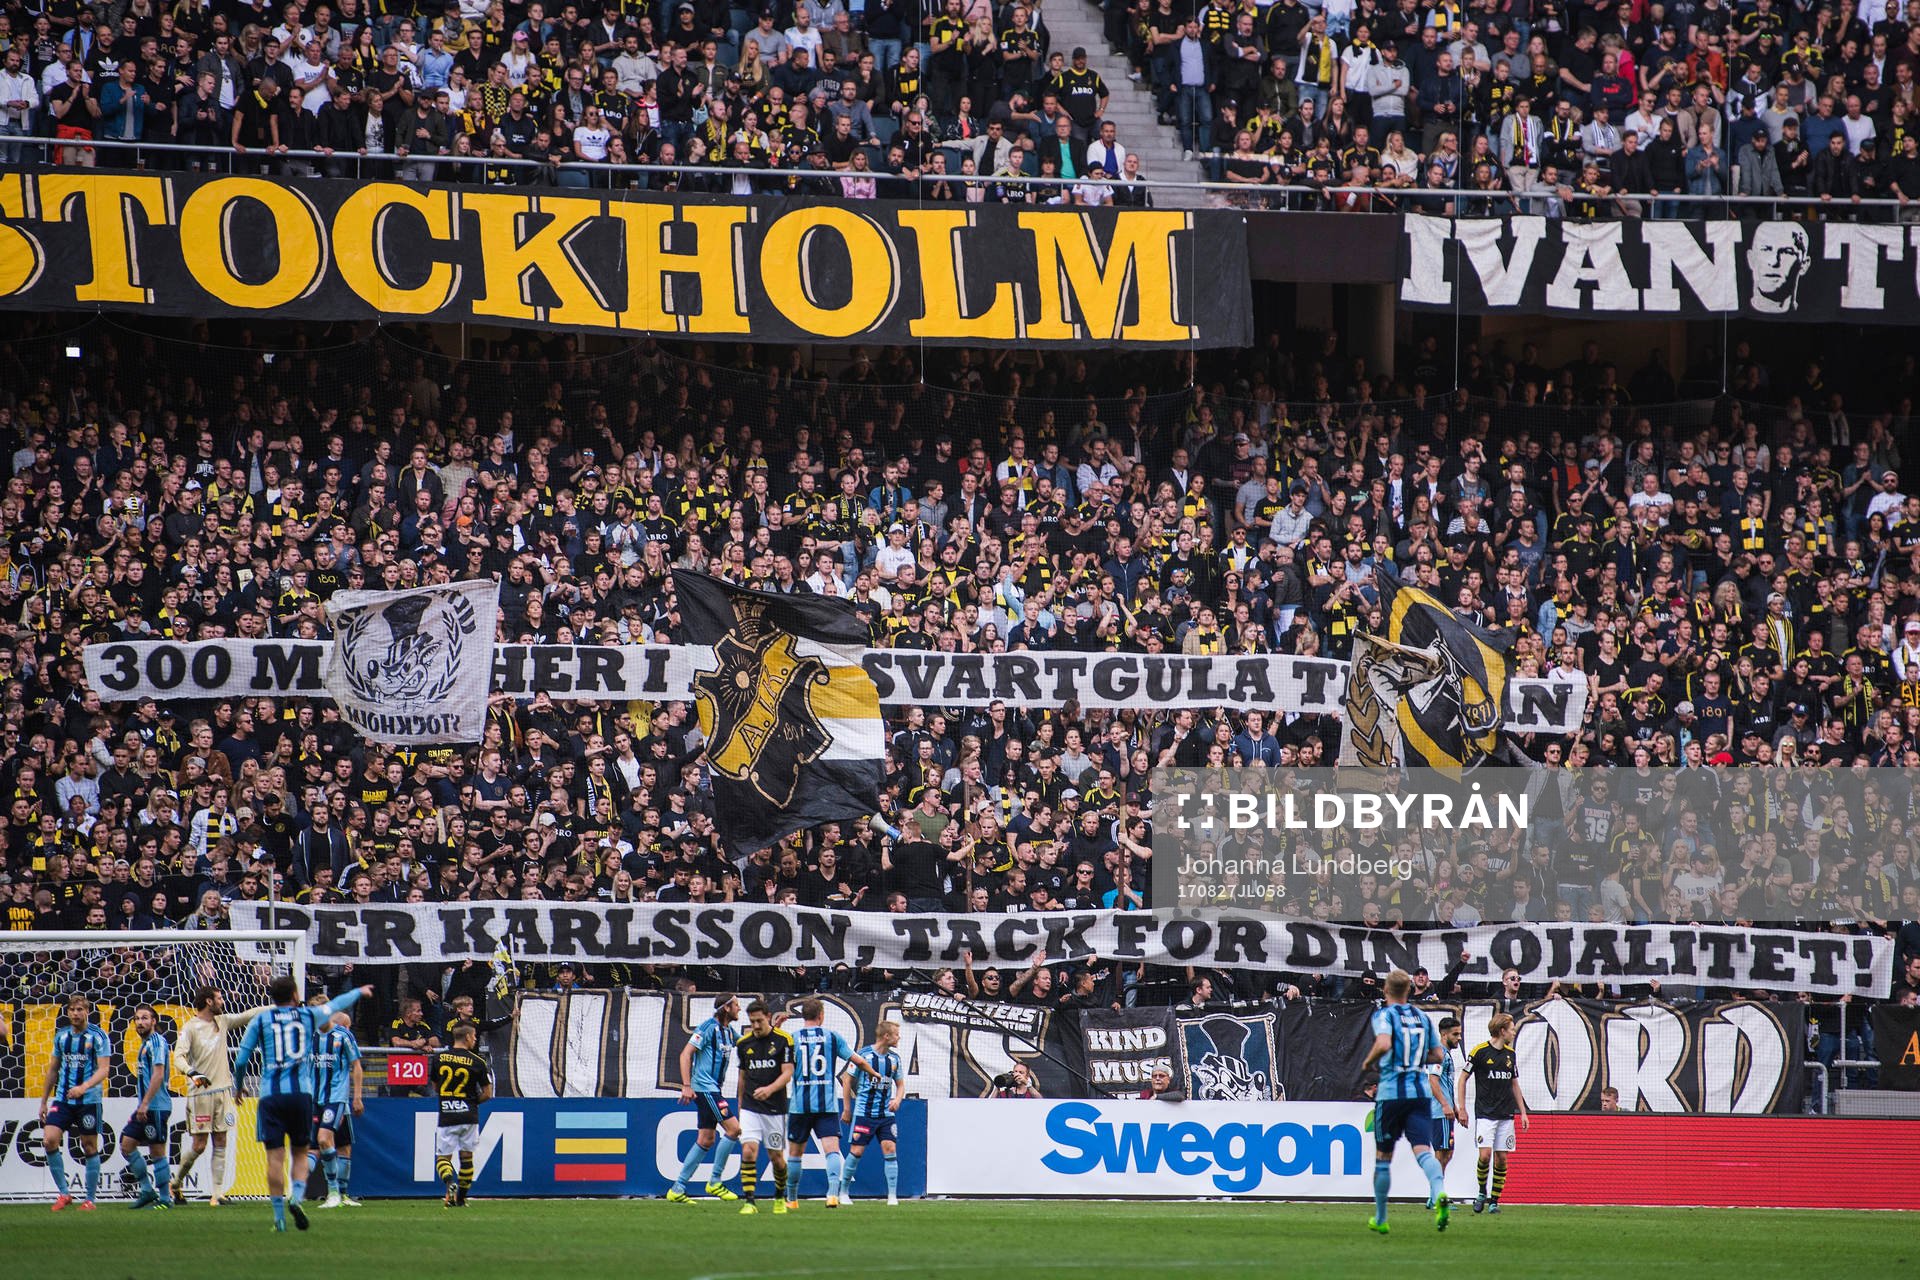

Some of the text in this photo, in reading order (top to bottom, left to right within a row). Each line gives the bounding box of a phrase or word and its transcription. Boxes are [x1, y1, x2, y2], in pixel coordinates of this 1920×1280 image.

[1401, 214, 1920, 311] IVAN T
[100, 644, 231, 691] 300
[863, 653, 1276, 702] SVARTGULA
[256, 906, 421, 957] PER
[438, 908, 875, 966] KARLSSON,
[893, 914, 1097, 962] TACK
[1286, 921, 1422, 973] DIN
[1441, 926, 1873, 988] LOJALITET!
[930, 1010, 968, 1024] COMING
[271, 1022, 306, 1062] 10
[1087, 1026, 1167, 1052] KIND
[1402, 1027, 1425, 1067] 17
[391, 1062, 424, 1078] 120
[439, 1053, 473, 1067] STEFANELLI
[800, 1044, 827, 1076] 16
[439, 1065, 470, 1098] 22
[441, 1100, 468, 1110] SVEA
[1041, 1102, 1362, 1192] Swegon
